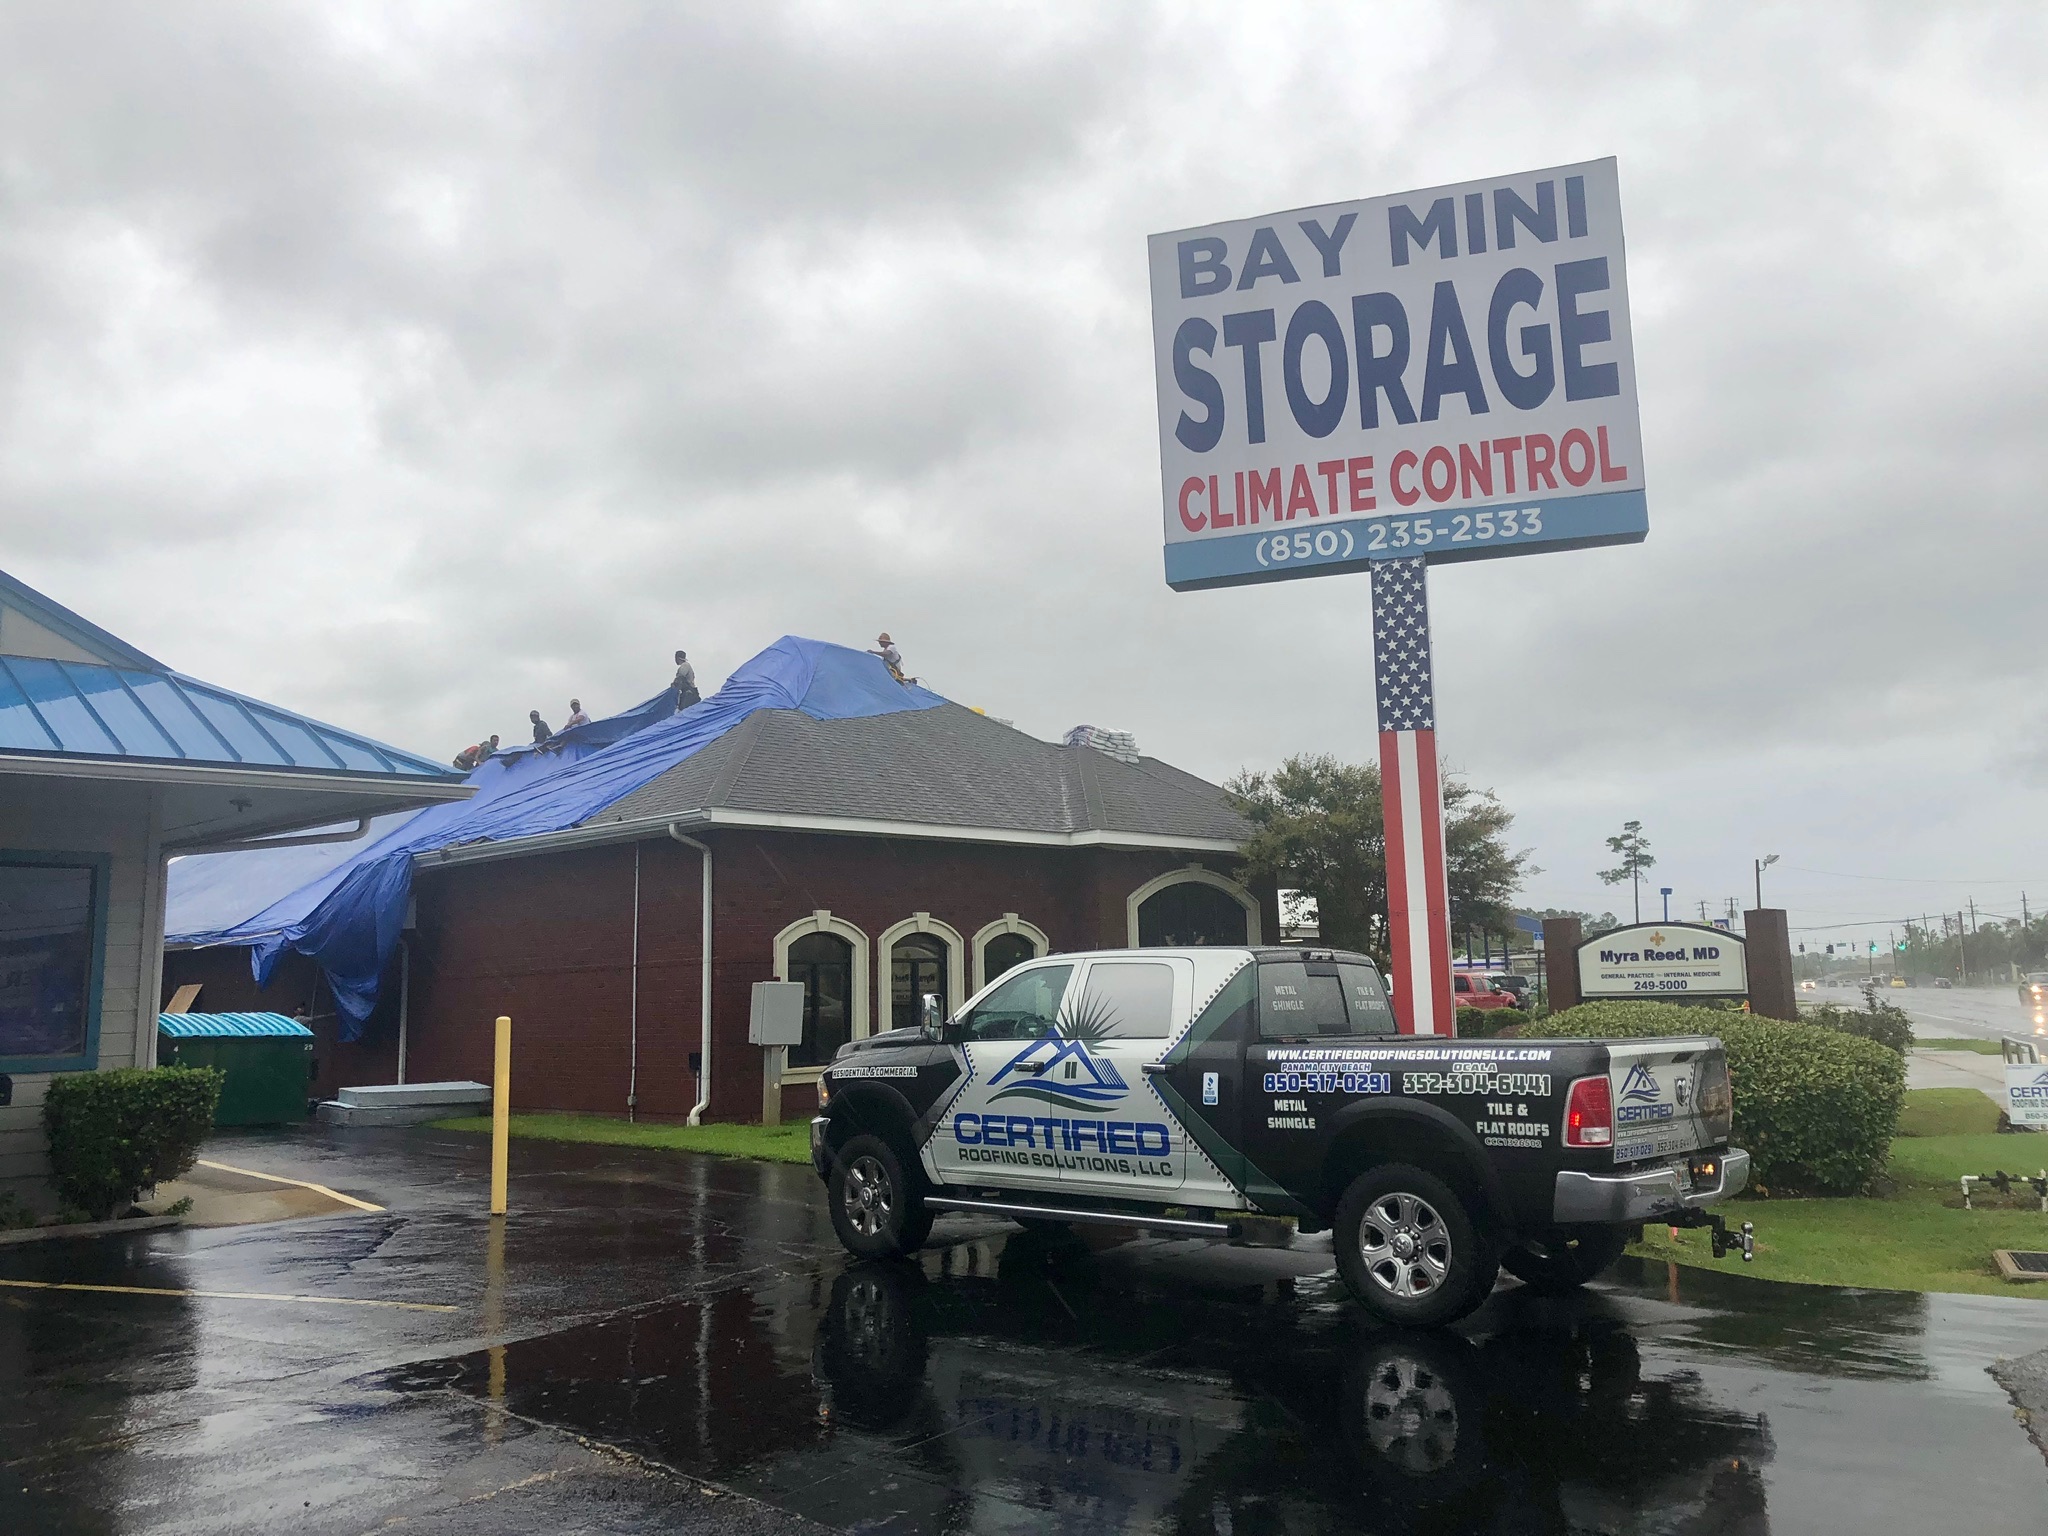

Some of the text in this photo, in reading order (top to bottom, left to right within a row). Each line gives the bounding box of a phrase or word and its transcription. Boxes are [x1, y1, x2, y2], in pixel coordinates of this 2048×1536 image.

[1178, 175, 1588, 299] BAY MINI
[1172, 256, 1620, 453] STORAGE
[1178, 425, 1627, 532] CLIMATE CONTROL
[1256, 508, 1543, 567] (850) 235-2533
[1600, 947, 1720, 965] Myra Reed, MD
[1274, 985, 1297, 995] METAL
[1634, 980, 1687, 990] 249-5000
[1272, 1000, 1304, 1011] SHINGLE
[1267, 1050, 1551, 1060] WWW.CERTIFIEDROOFINGSOLUTIONSLLC.COM
[832, 1066, 918, 1078] RESIDENTIAL & COMMERCIAL
[1281, 1063, 1372, 1072] PANAMA CITY BEACH
[1453, 1063, 1498, 1072] OCALA
[1264, 1073, 1390, 1093] 850-517-0291
[1403, 1073, 1551, 1096] 352-304-6441
[1274, 1100, 1307, 1111] METAL
[1487, 1103, 1528, 1116] TILE &
[2012, 1099, 2039, 1108] ROOFING
[1617, 1103, 1674, 1121] CERTIFIED
[1267, 1117, 1316, 1129] SHINGLE
[1476, 1121, 1550, 1137] FLAT ROOFS
[953, 1113, 1171, 1157] CERTIFIED
[1616, 1144, 1653, 1159] 850-517-0291
[959, 1148, 1173, 1177] ROOFING SOLUTIONS, LLC
